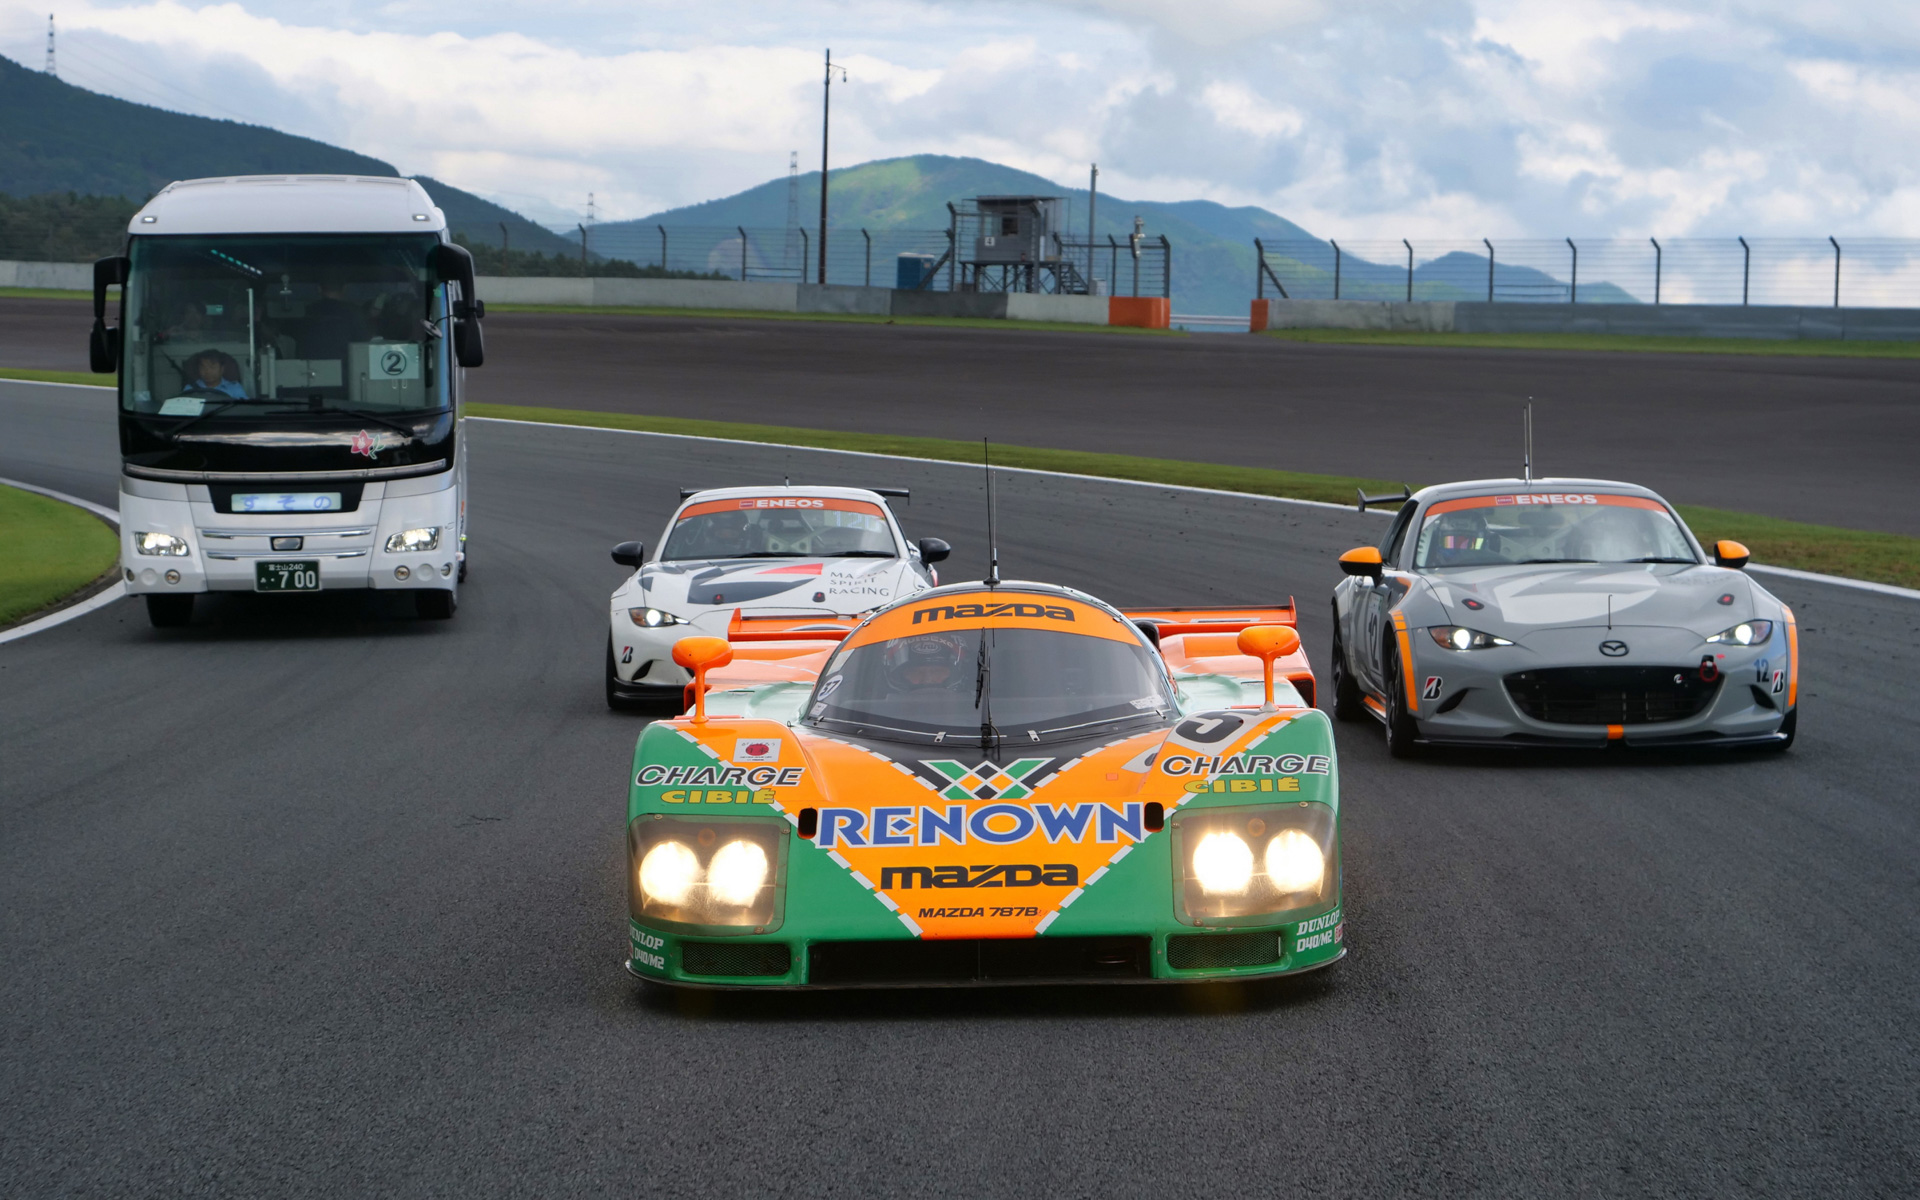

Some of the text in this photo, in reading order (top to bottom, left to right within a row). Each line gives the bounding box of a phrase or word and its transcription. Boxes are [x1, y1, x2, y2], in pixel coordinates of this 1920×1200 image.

[756, 499, 824, 508] ENEOS
[1516, 494, 1598, 504] ENEOS
[830, 570, 888, 579] MAA
[829, 587, 889, 597] RACING
[1753, 658, 1770, 683] 12
[1161, 753, 1331, 776] CHARGE
[636, 764, 806, 787] CHARGE
[1184, 776, 1300, 794] CIBIÉ
[661, 788, 776, 805] CIBIÉ
[815, 802, 1146, 849] RENOWN
[918, 906, 1039, 918] MAZDA 787B
[1296, 909, 1340, 936] DUNLOP
[629, 923, 664, 950] UNLOP
